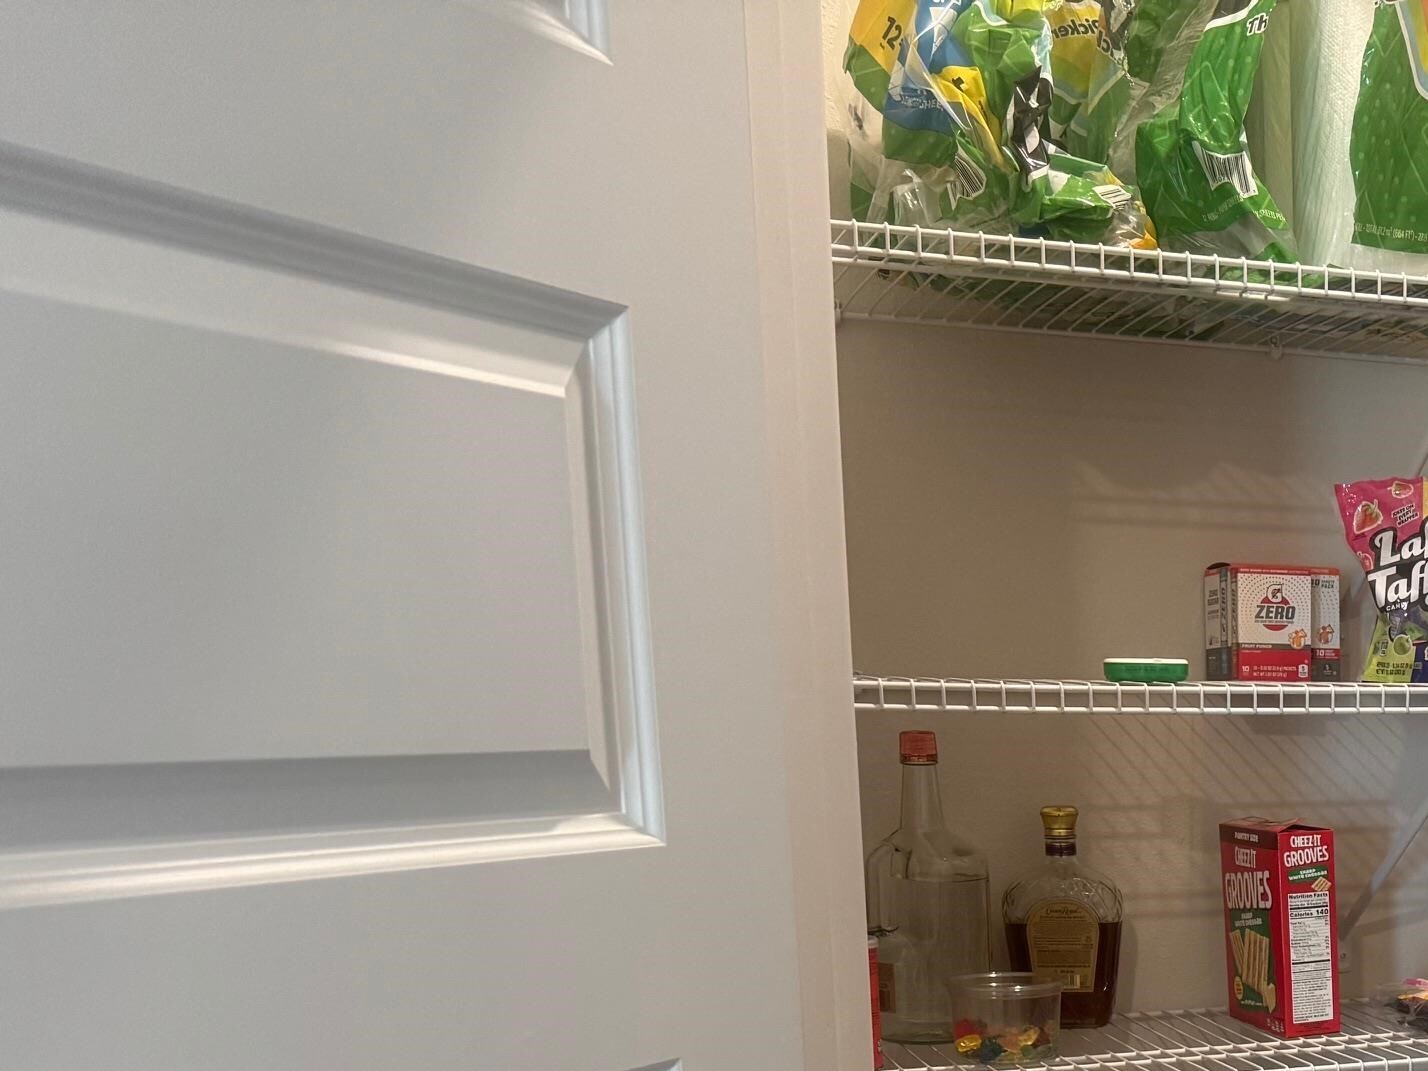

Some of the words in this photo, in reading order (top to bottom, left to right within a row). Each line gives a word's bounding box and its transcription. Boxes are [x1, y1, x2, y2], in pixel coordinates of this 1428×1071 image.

[881, 16, 903, 50] 12
[1254, 604, 1296, 620] ZERO
[1283, 845, 1329, 867] GROOVES
[1225, 870, 1272, 909] GROOVES
